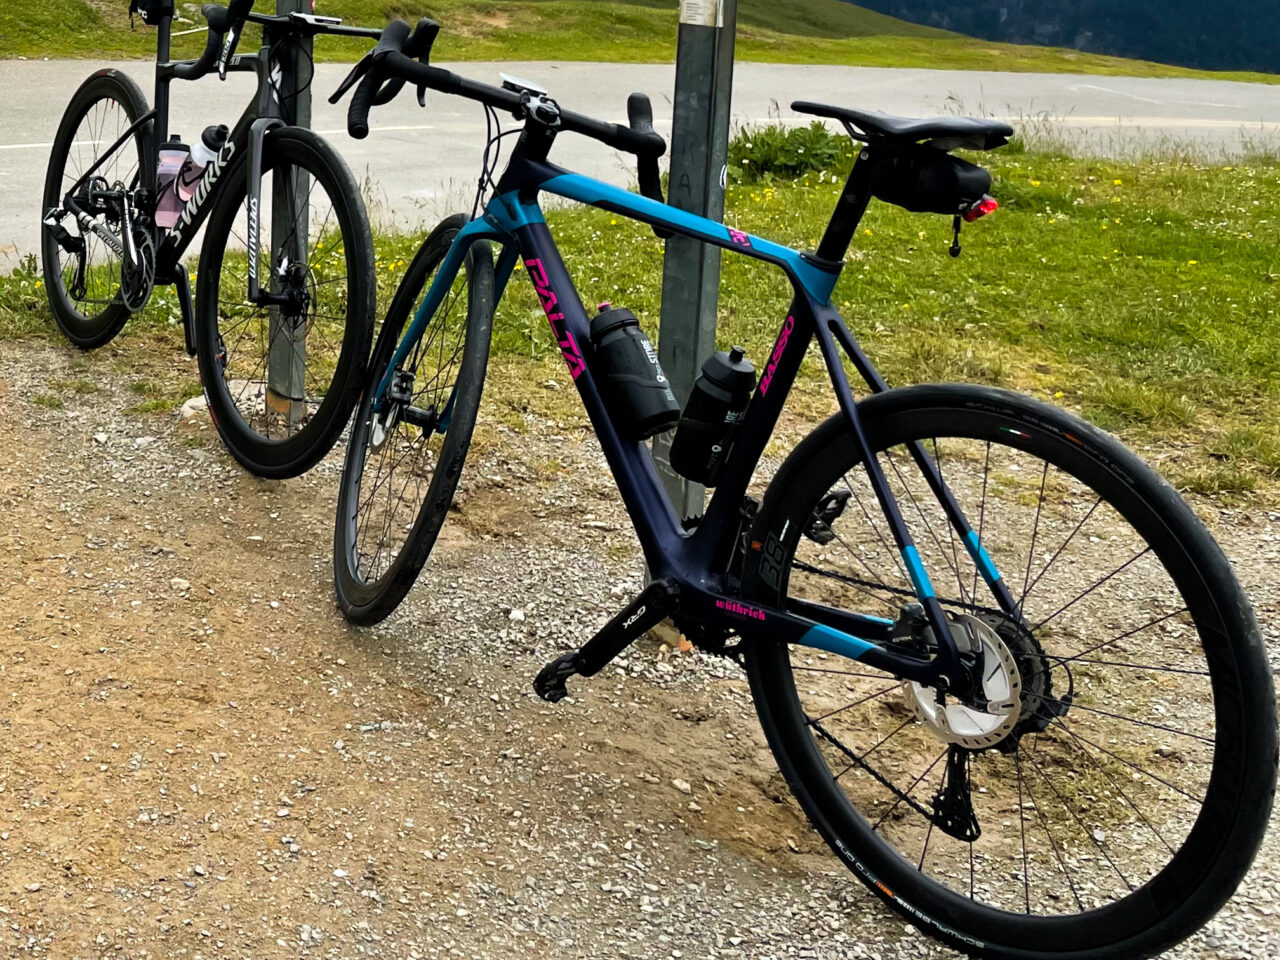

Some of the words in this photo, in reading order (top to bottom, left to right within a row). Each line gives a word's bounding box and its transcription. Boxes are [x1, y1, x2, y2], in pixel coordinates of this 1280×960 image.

[170, 140, 236, 248] S-WORKS
[525, 257, 586, 380] PALTA
[760, 315, 795, 398] BASSO
[622, 605, 646, 629] GRX
